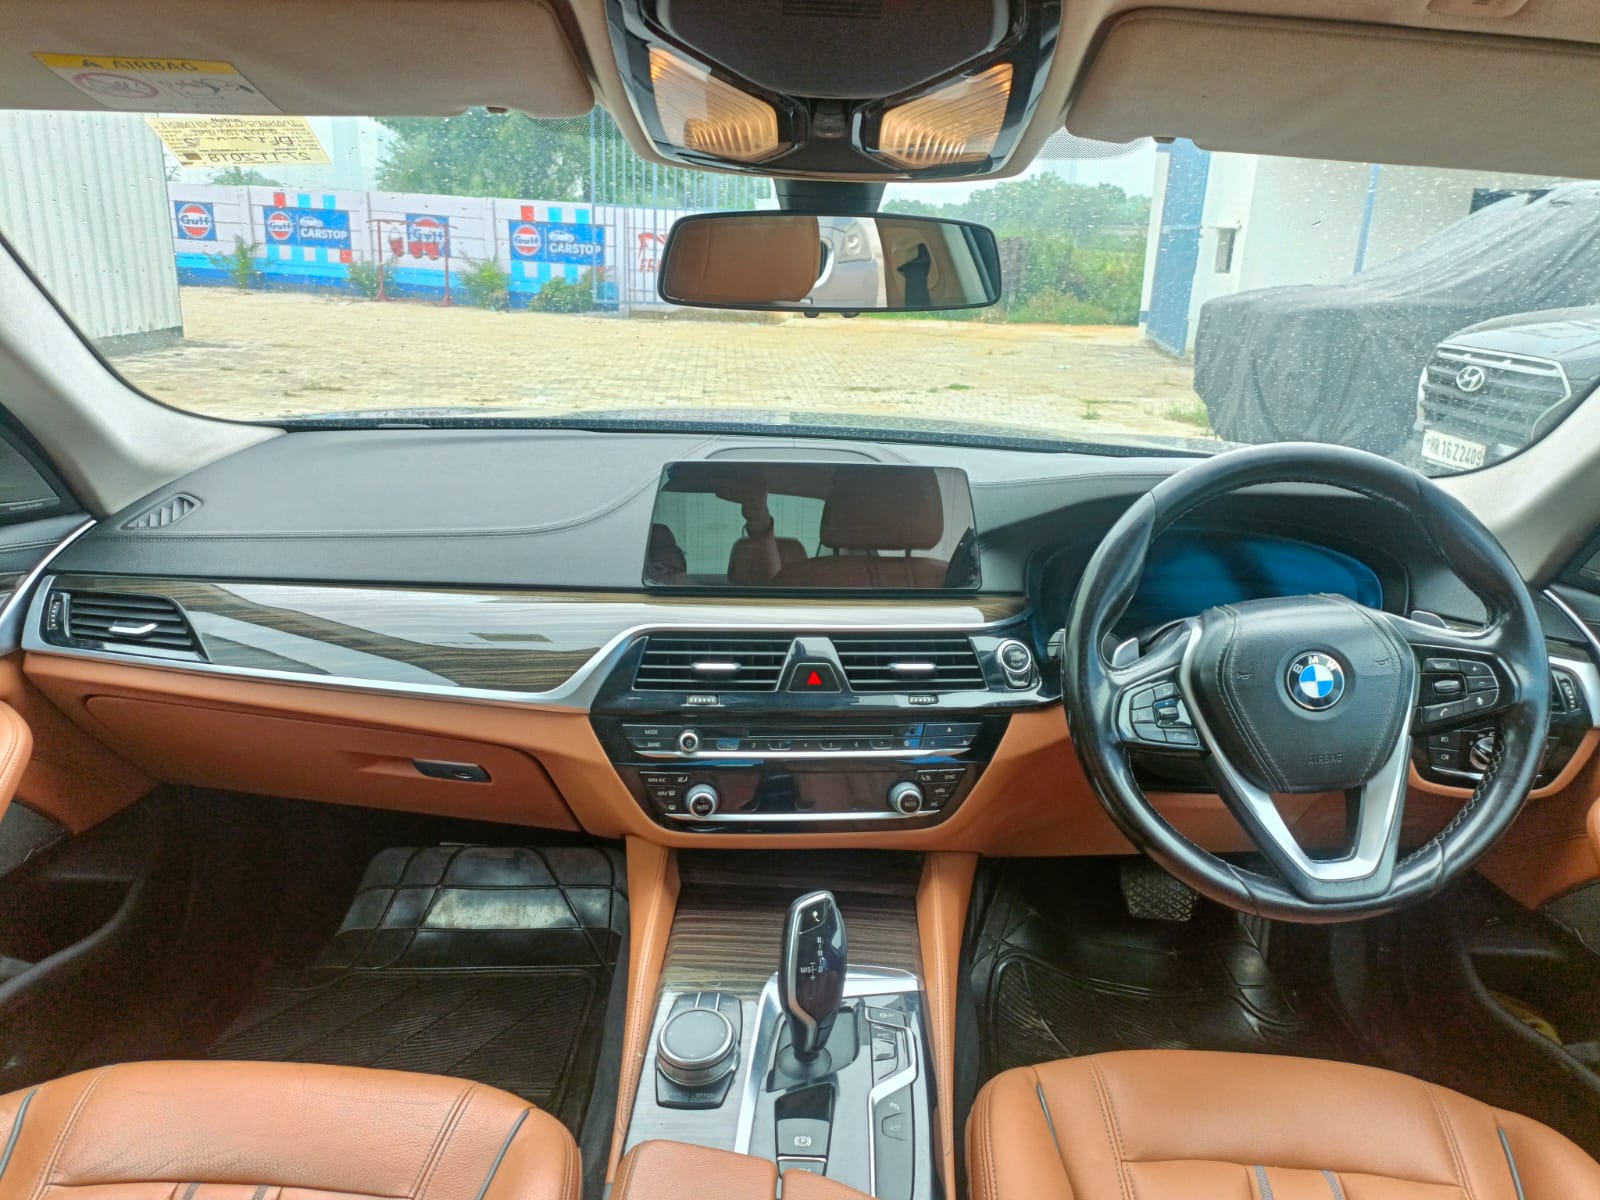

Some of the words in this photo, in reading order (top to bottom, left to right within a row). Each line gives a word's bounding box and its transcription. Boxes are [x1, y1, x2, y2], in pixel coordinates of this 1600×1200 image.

[112, 60, 199, 72] AIRBAG
[180, 214, 209, 226] Gulf
[270, 221, 292, 230] Gulf
[301, 228, 348, 240] CARSTOP
[514, 234, 539, 244] Gulf
[550, 243, 601, 255] CARSTOP
[1292, 655, 1338, 674] BMW
